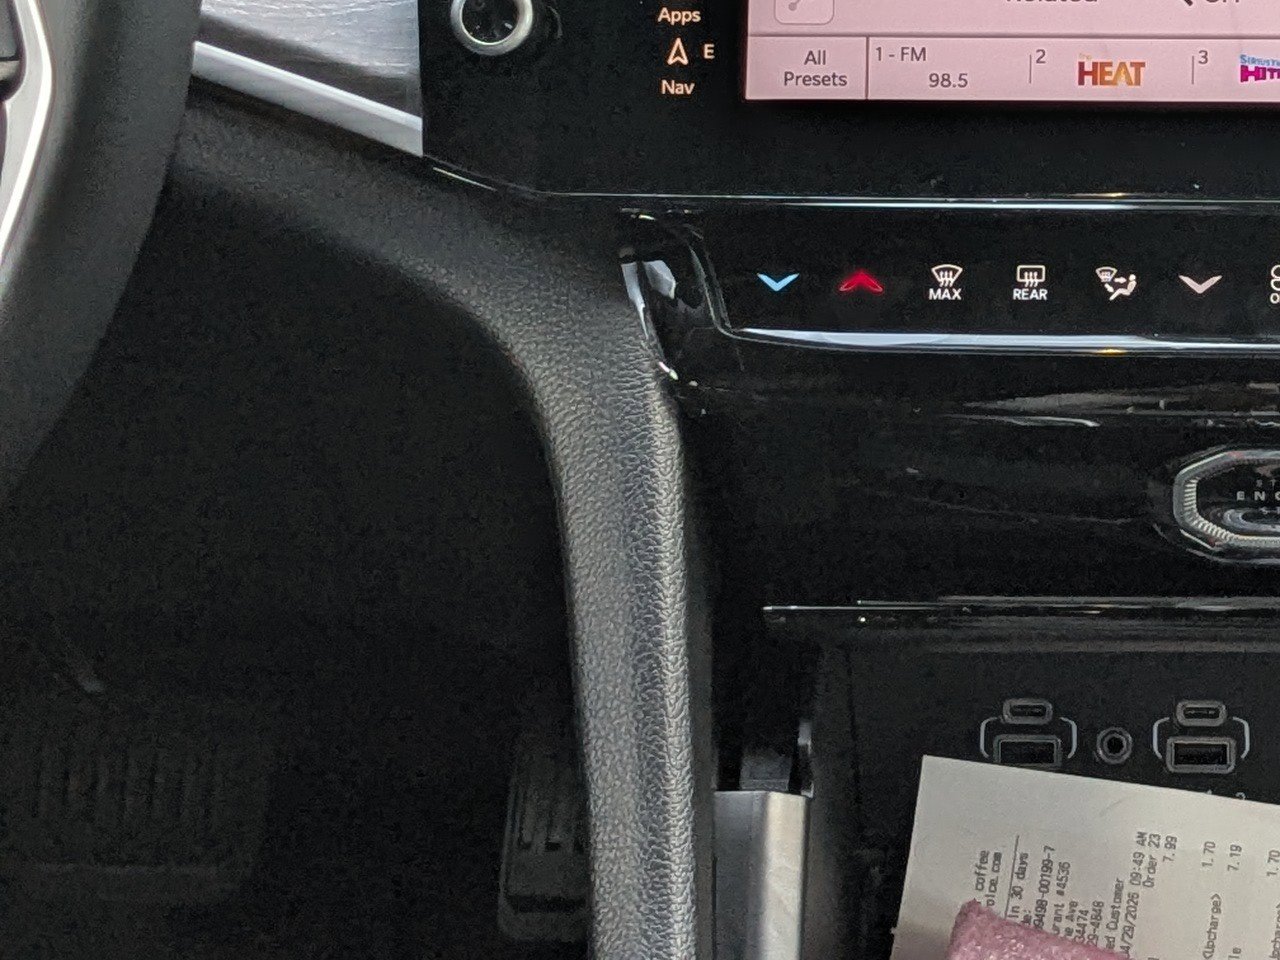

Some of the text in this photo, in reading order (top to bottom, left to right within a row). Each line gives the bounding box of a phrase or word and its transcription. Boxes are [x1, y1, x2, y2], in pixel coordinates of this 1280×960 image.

[657, 8, 701, 25] Apps
[703, 44, 715, 59] E
[804, 50, 827, 66] All
[875, 46, 883, 62] 1
[900, 47, 927, 62] FM
[1035, 49, 1046, 64] 2
[1198, 50, 1208, 65] 3
[783, 72, 848, 87] Presets
[929, 73, 968, 88] 98.5
[1077, 61, 1146, 86] HEAT
[661, 79, 695, 95] Nav
[928, 287, 963, 301] MAX
[1012, 287, 1048, 301] REAR
[1136, 831, 1147, 847] AM
[1015, 852, 1028, 880] days
[1130, 851, 1145, 886] 09:49
[1142, 833, 1161, 889] Order 23
[974, 850, 990, 891] coffee
[1011, 886, 1024, 900] 30
[1033, 845, 1056, 930] 9498-00199-7
[1106, 877, 1125, 931] Customer
